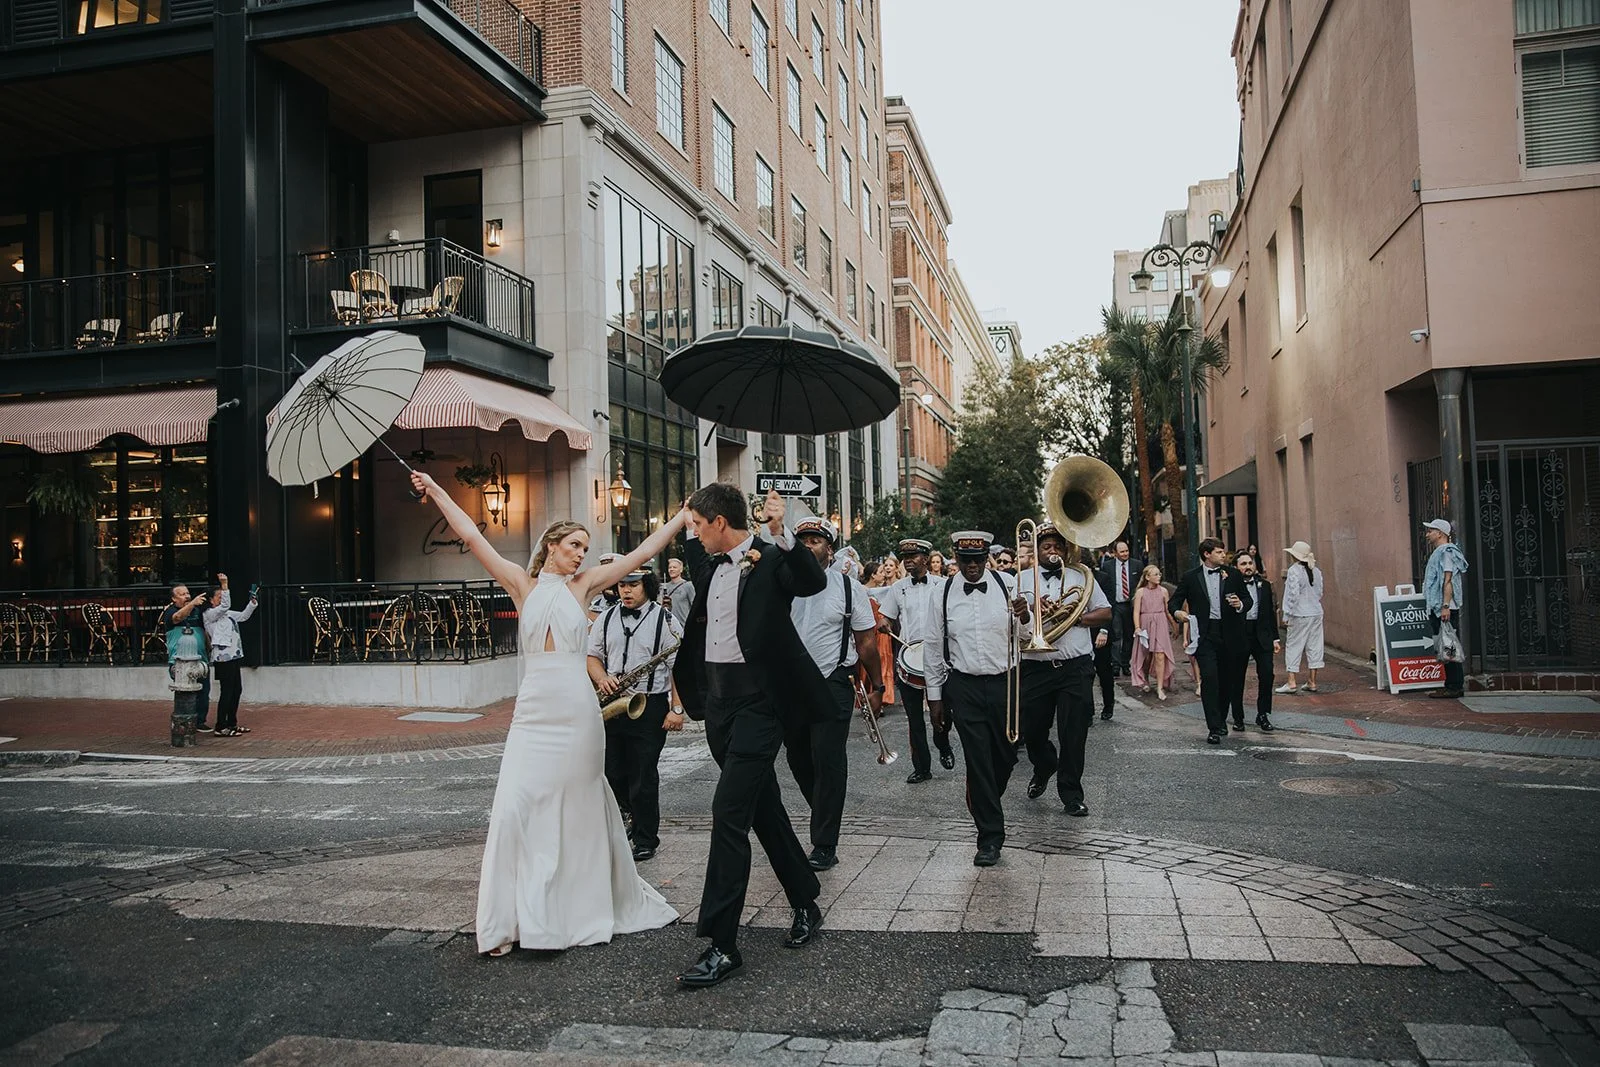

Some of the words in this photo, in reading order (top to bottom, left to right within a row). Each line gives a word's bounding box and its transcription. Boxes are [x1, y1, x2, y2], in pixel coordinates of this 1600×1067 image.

[763, 480, 780, 489] ONE
[783, 480, 802, 489] WAY
[1384, 609, 1430, 626] BARONN
[1399, 664, 1442, 681] Coca-Cola
